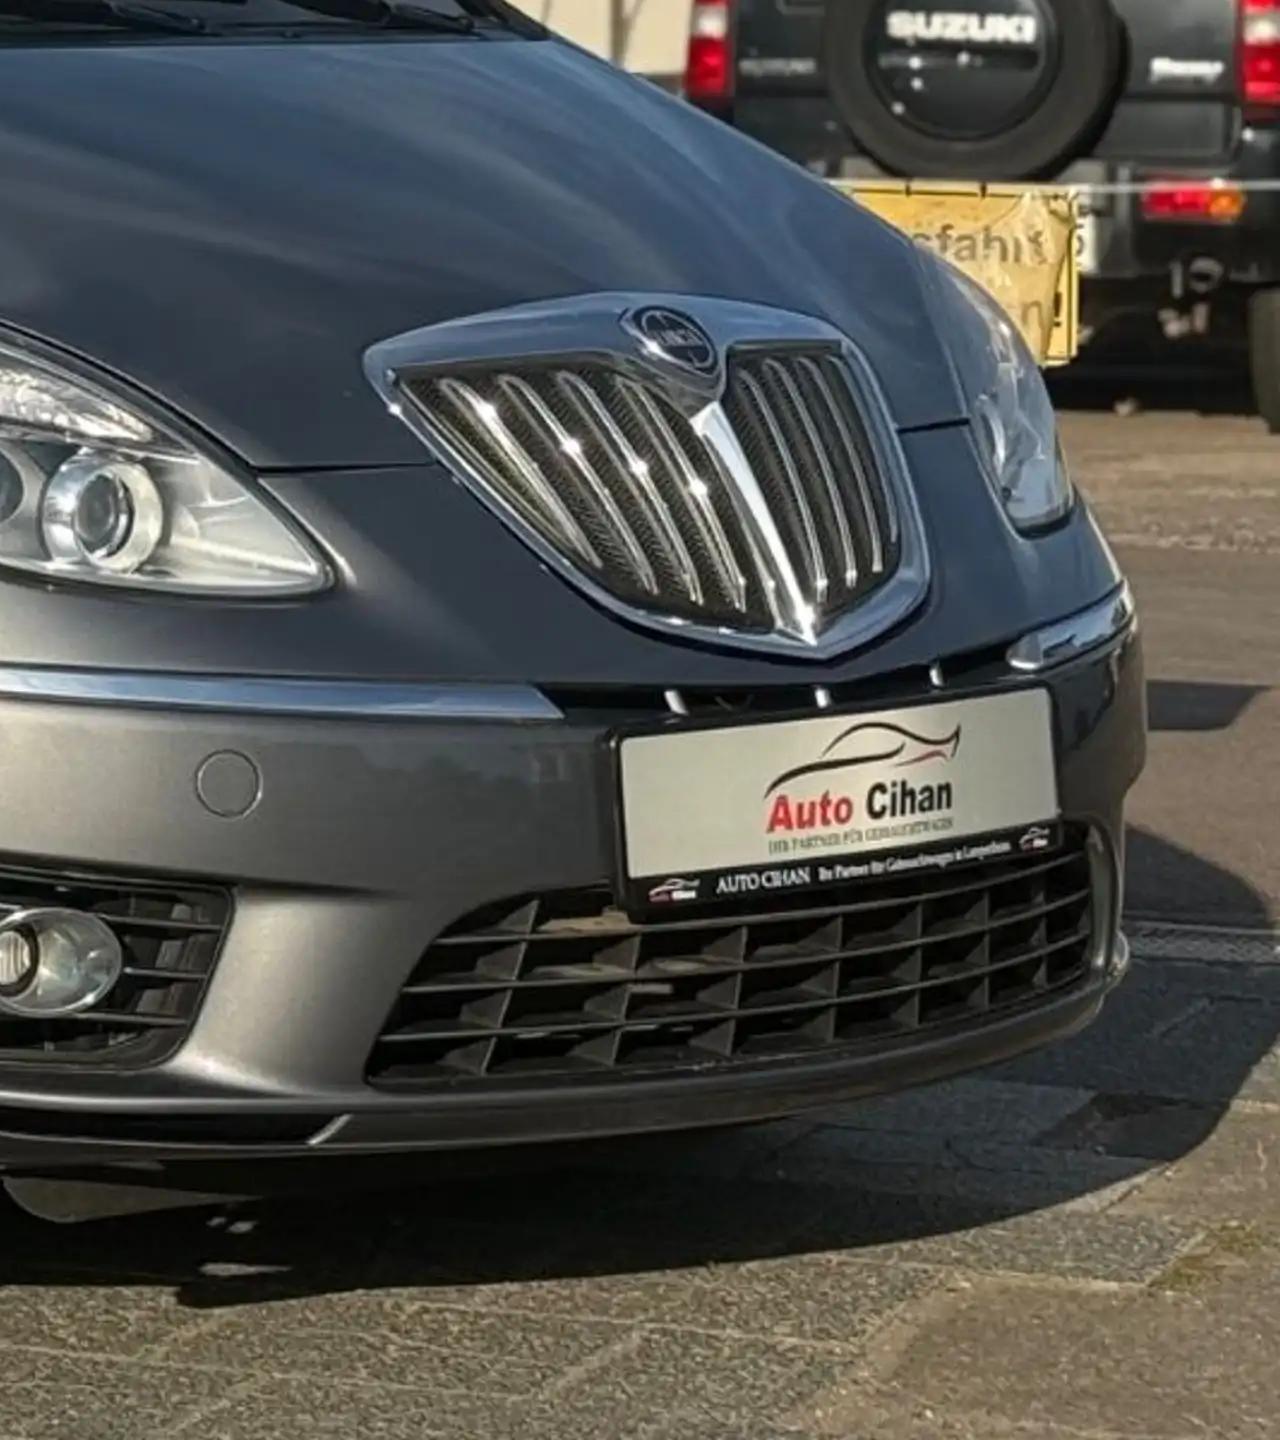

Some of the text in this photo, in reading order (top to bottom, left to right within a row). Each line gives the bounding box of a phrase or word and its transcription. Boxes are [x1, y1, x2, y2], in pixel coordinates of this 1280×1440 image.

[886, 11, 1037, 44] SUZUKI
[766, 779, 953, 834] Auto Cihan
[716, 875, 761, 894] AUTO
[761, 866, 812, 889] CIHAN
